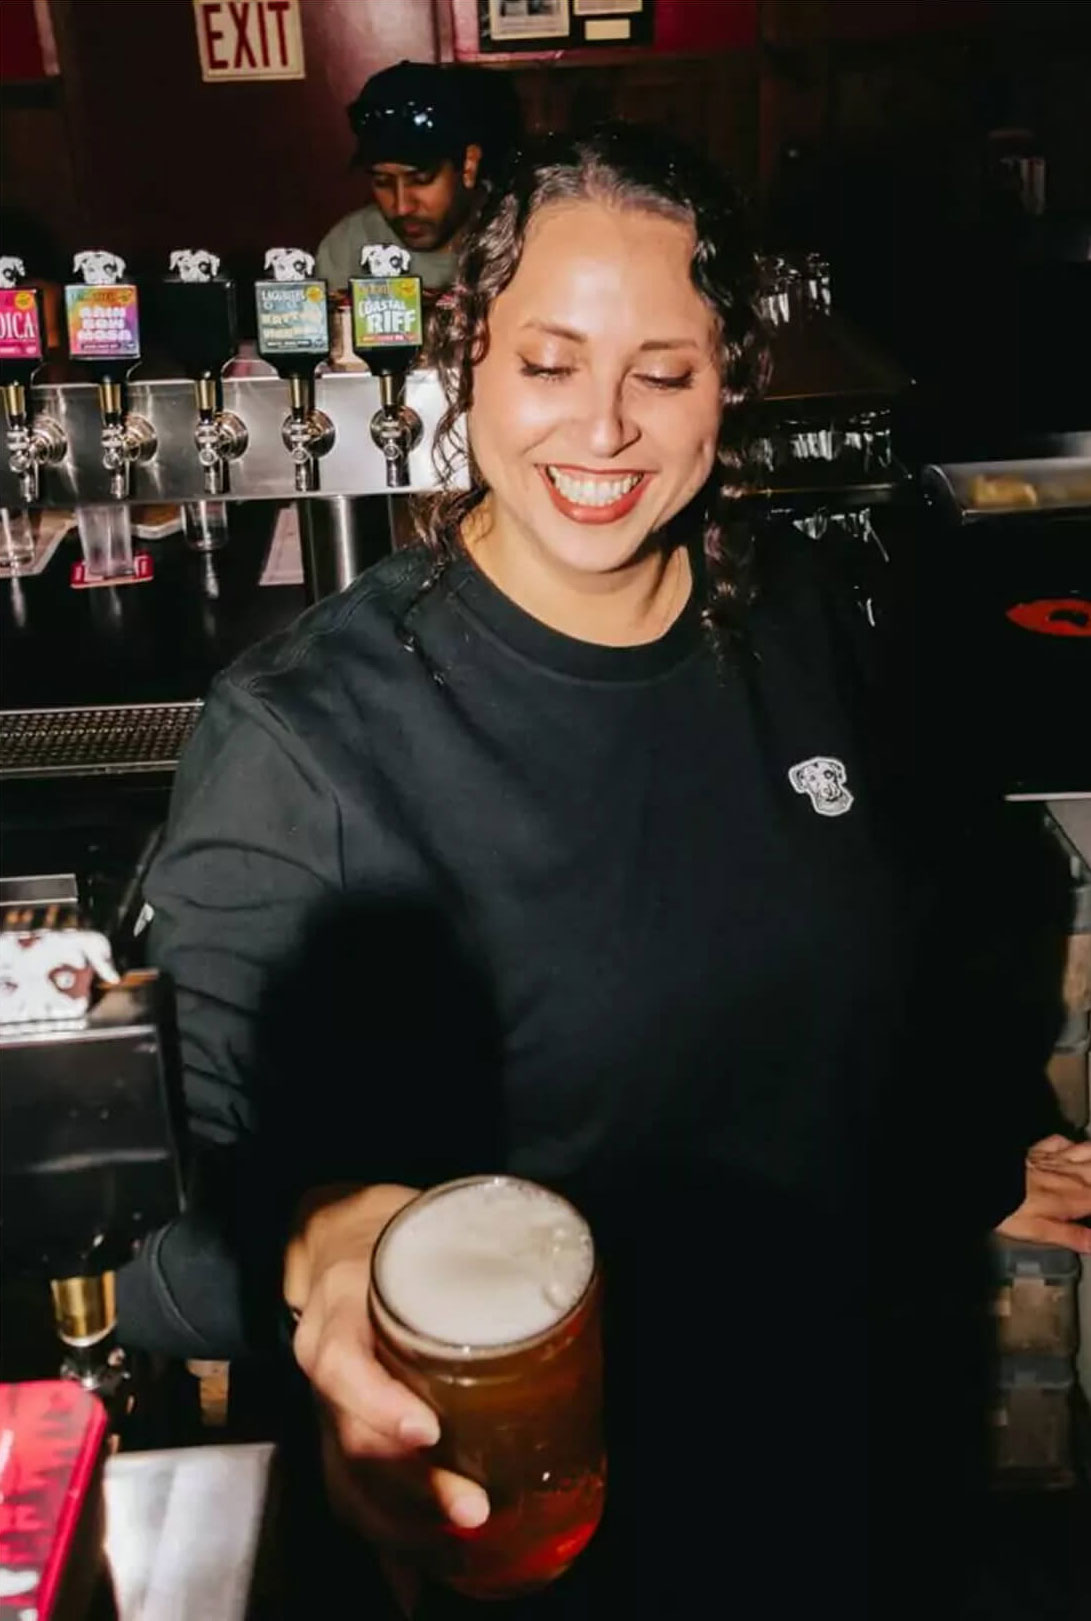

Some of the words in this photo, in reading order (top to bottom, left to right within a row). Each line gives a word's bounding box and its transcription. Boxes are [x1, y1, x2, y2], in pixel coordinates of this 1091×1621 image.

[202, 1, 290, 70] EXIT
[358, 296, 407, 318] COASTAL
[367, 309, 416, 333] RIFF
